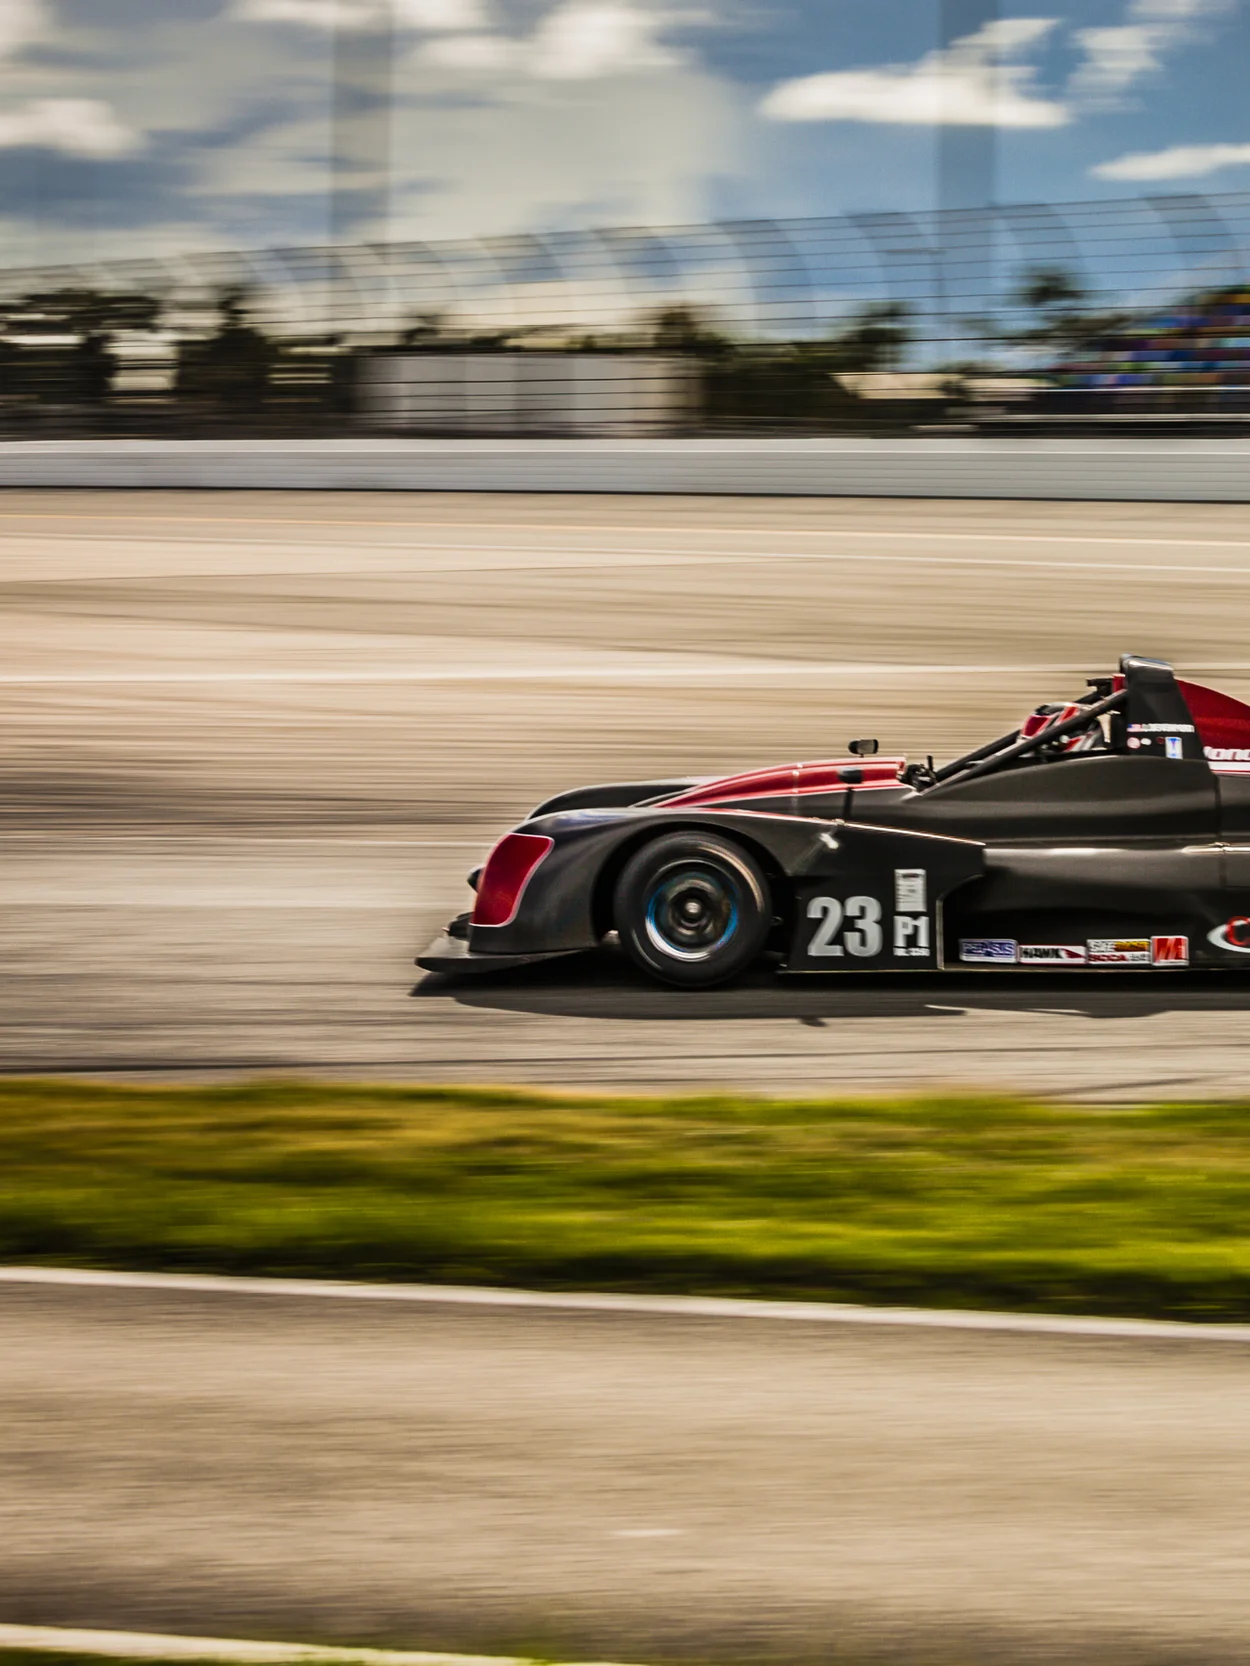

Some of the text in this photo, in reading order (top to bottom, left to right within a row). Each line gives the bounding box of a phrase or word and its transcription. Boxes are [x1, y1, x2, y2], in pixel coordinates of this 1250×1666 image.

[806, 896, 883, 957] 23
[893, 915, 930, 947] P1
[1020, 947, 1063, 959] HAWK
